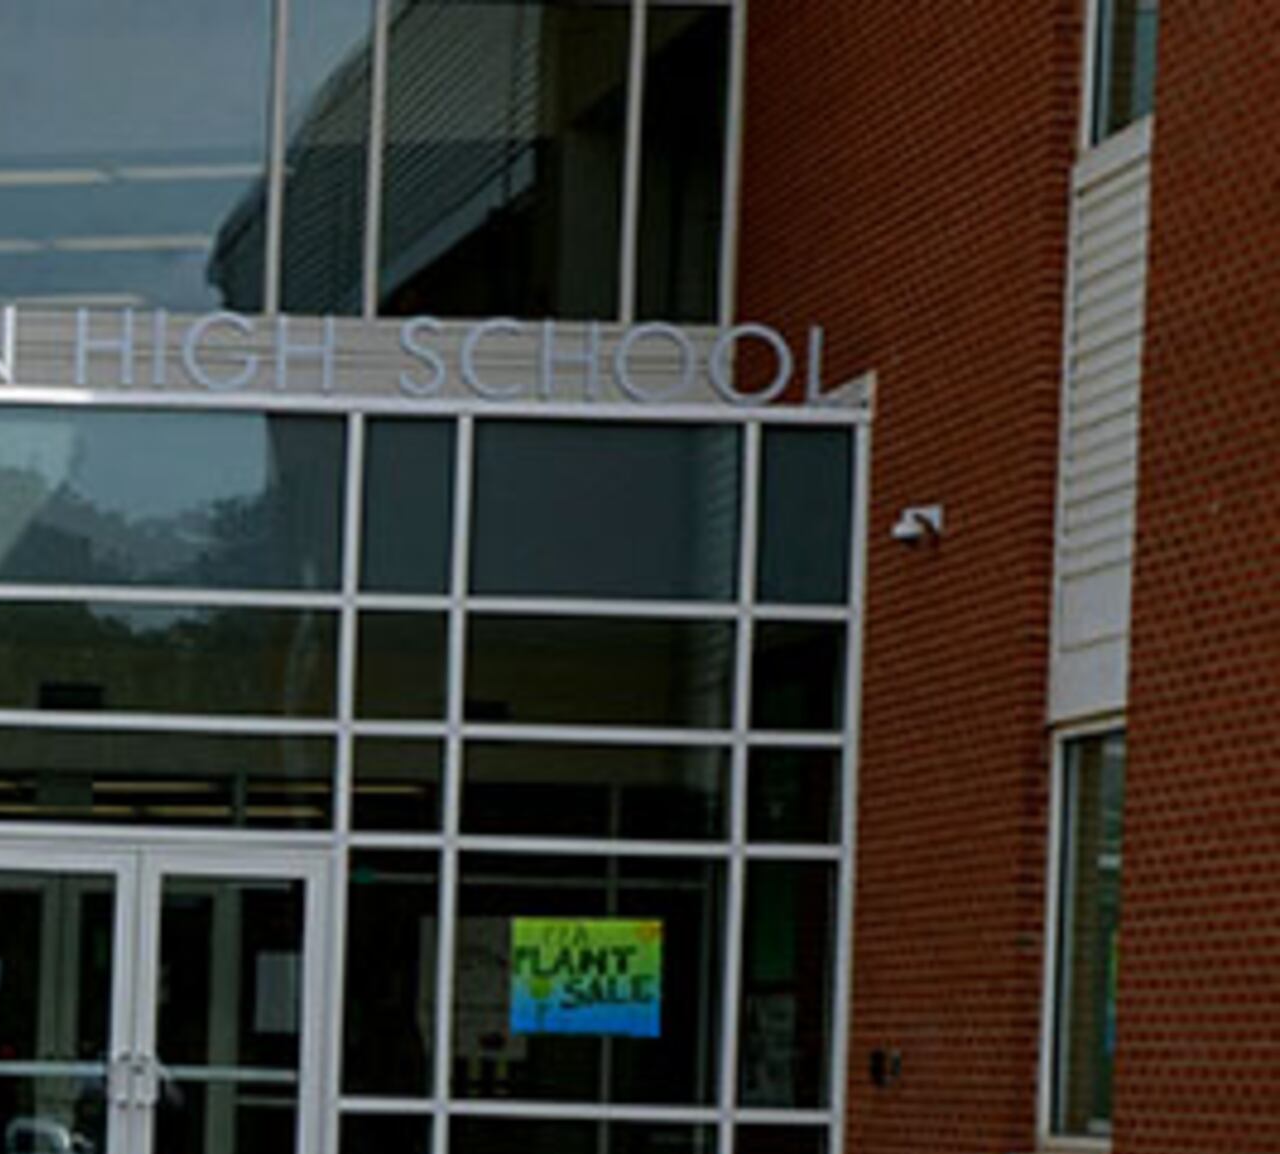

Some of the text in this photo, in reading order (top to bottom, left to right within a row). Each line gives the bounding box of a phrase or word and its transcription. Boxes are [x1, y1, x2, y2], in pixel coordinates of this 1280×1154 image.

[73, 307, 336, 394] HIGH
[397, 316, 852, 406] SCHOOL
[513, 946, 638, 976] PLANT
[559, 974, 656, 1010] SALE
